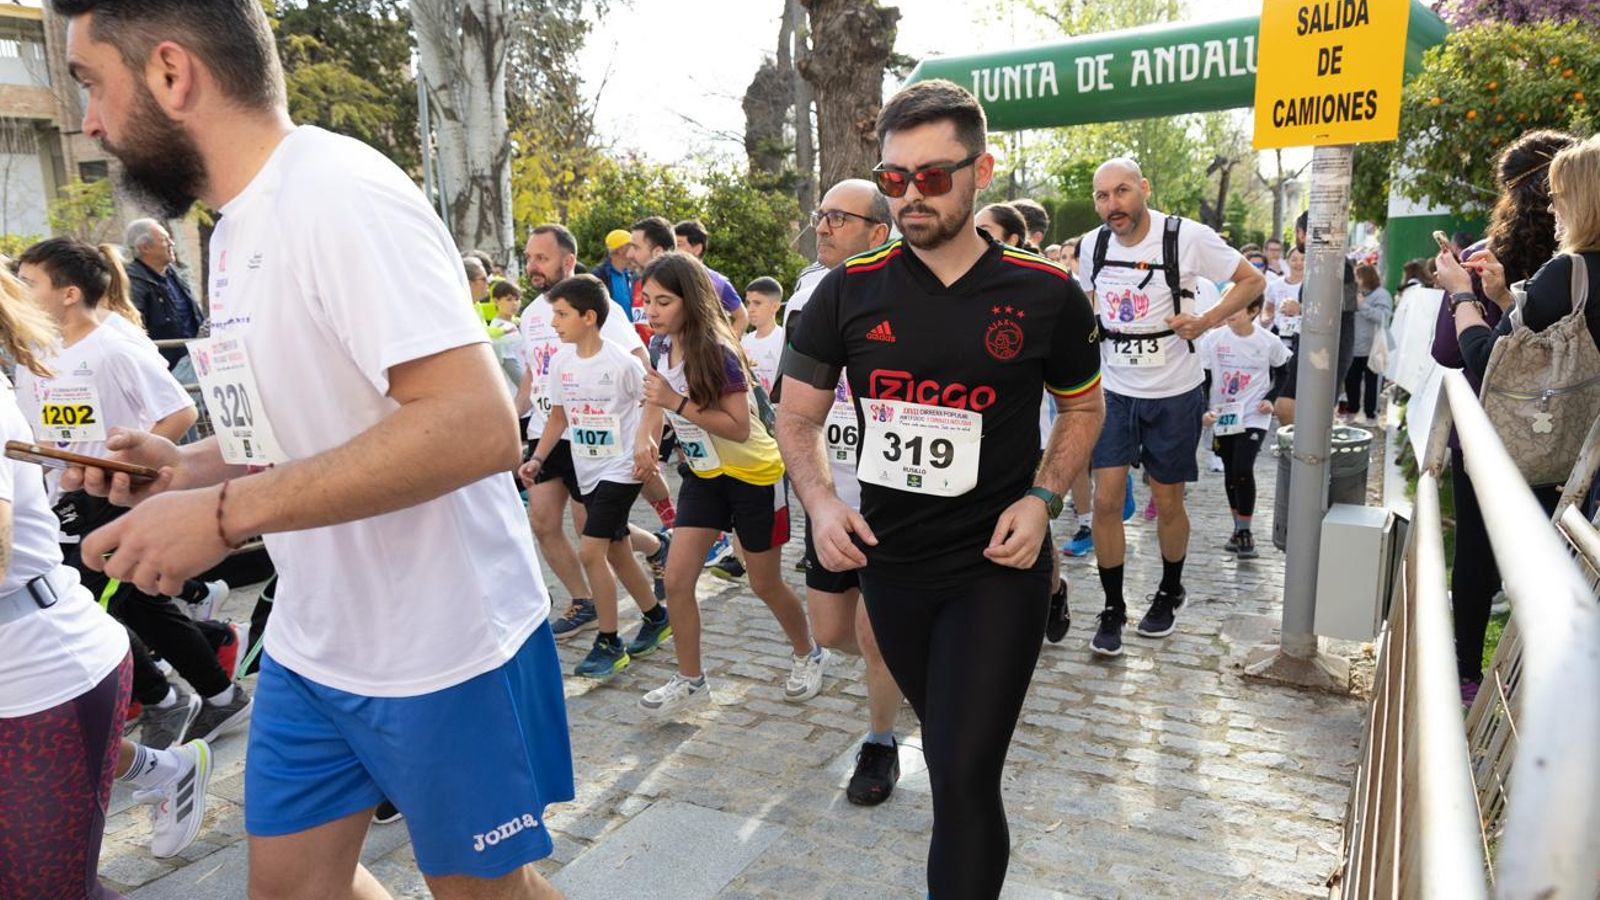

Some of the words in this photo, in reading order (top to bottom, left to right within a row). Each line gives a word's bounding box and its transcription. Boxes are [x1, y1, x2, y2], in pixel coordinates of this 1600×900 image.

[1297, 0, 1369, 36] SALIDA
[1317, 45, 1343, 76] DE
[971, 61, 1059, 103] JUNTA
[1075, 53, 1114, 94] DE
[1273, 89, 1377, 128] CAMIONES
[866, 332, 896, 343] adidas
[1113, 339, 1159, 354] 1213
[42, 405, 96, 425] 1202
[213, 383, 253, 427] 320
[1218, 413, 1236, 426] 437
[576, 429, 608, 446] 107
[827, 424, 858, 446] 06
[882, 431, 955, 469] 319
[473, 813, 539, 852] Joma
